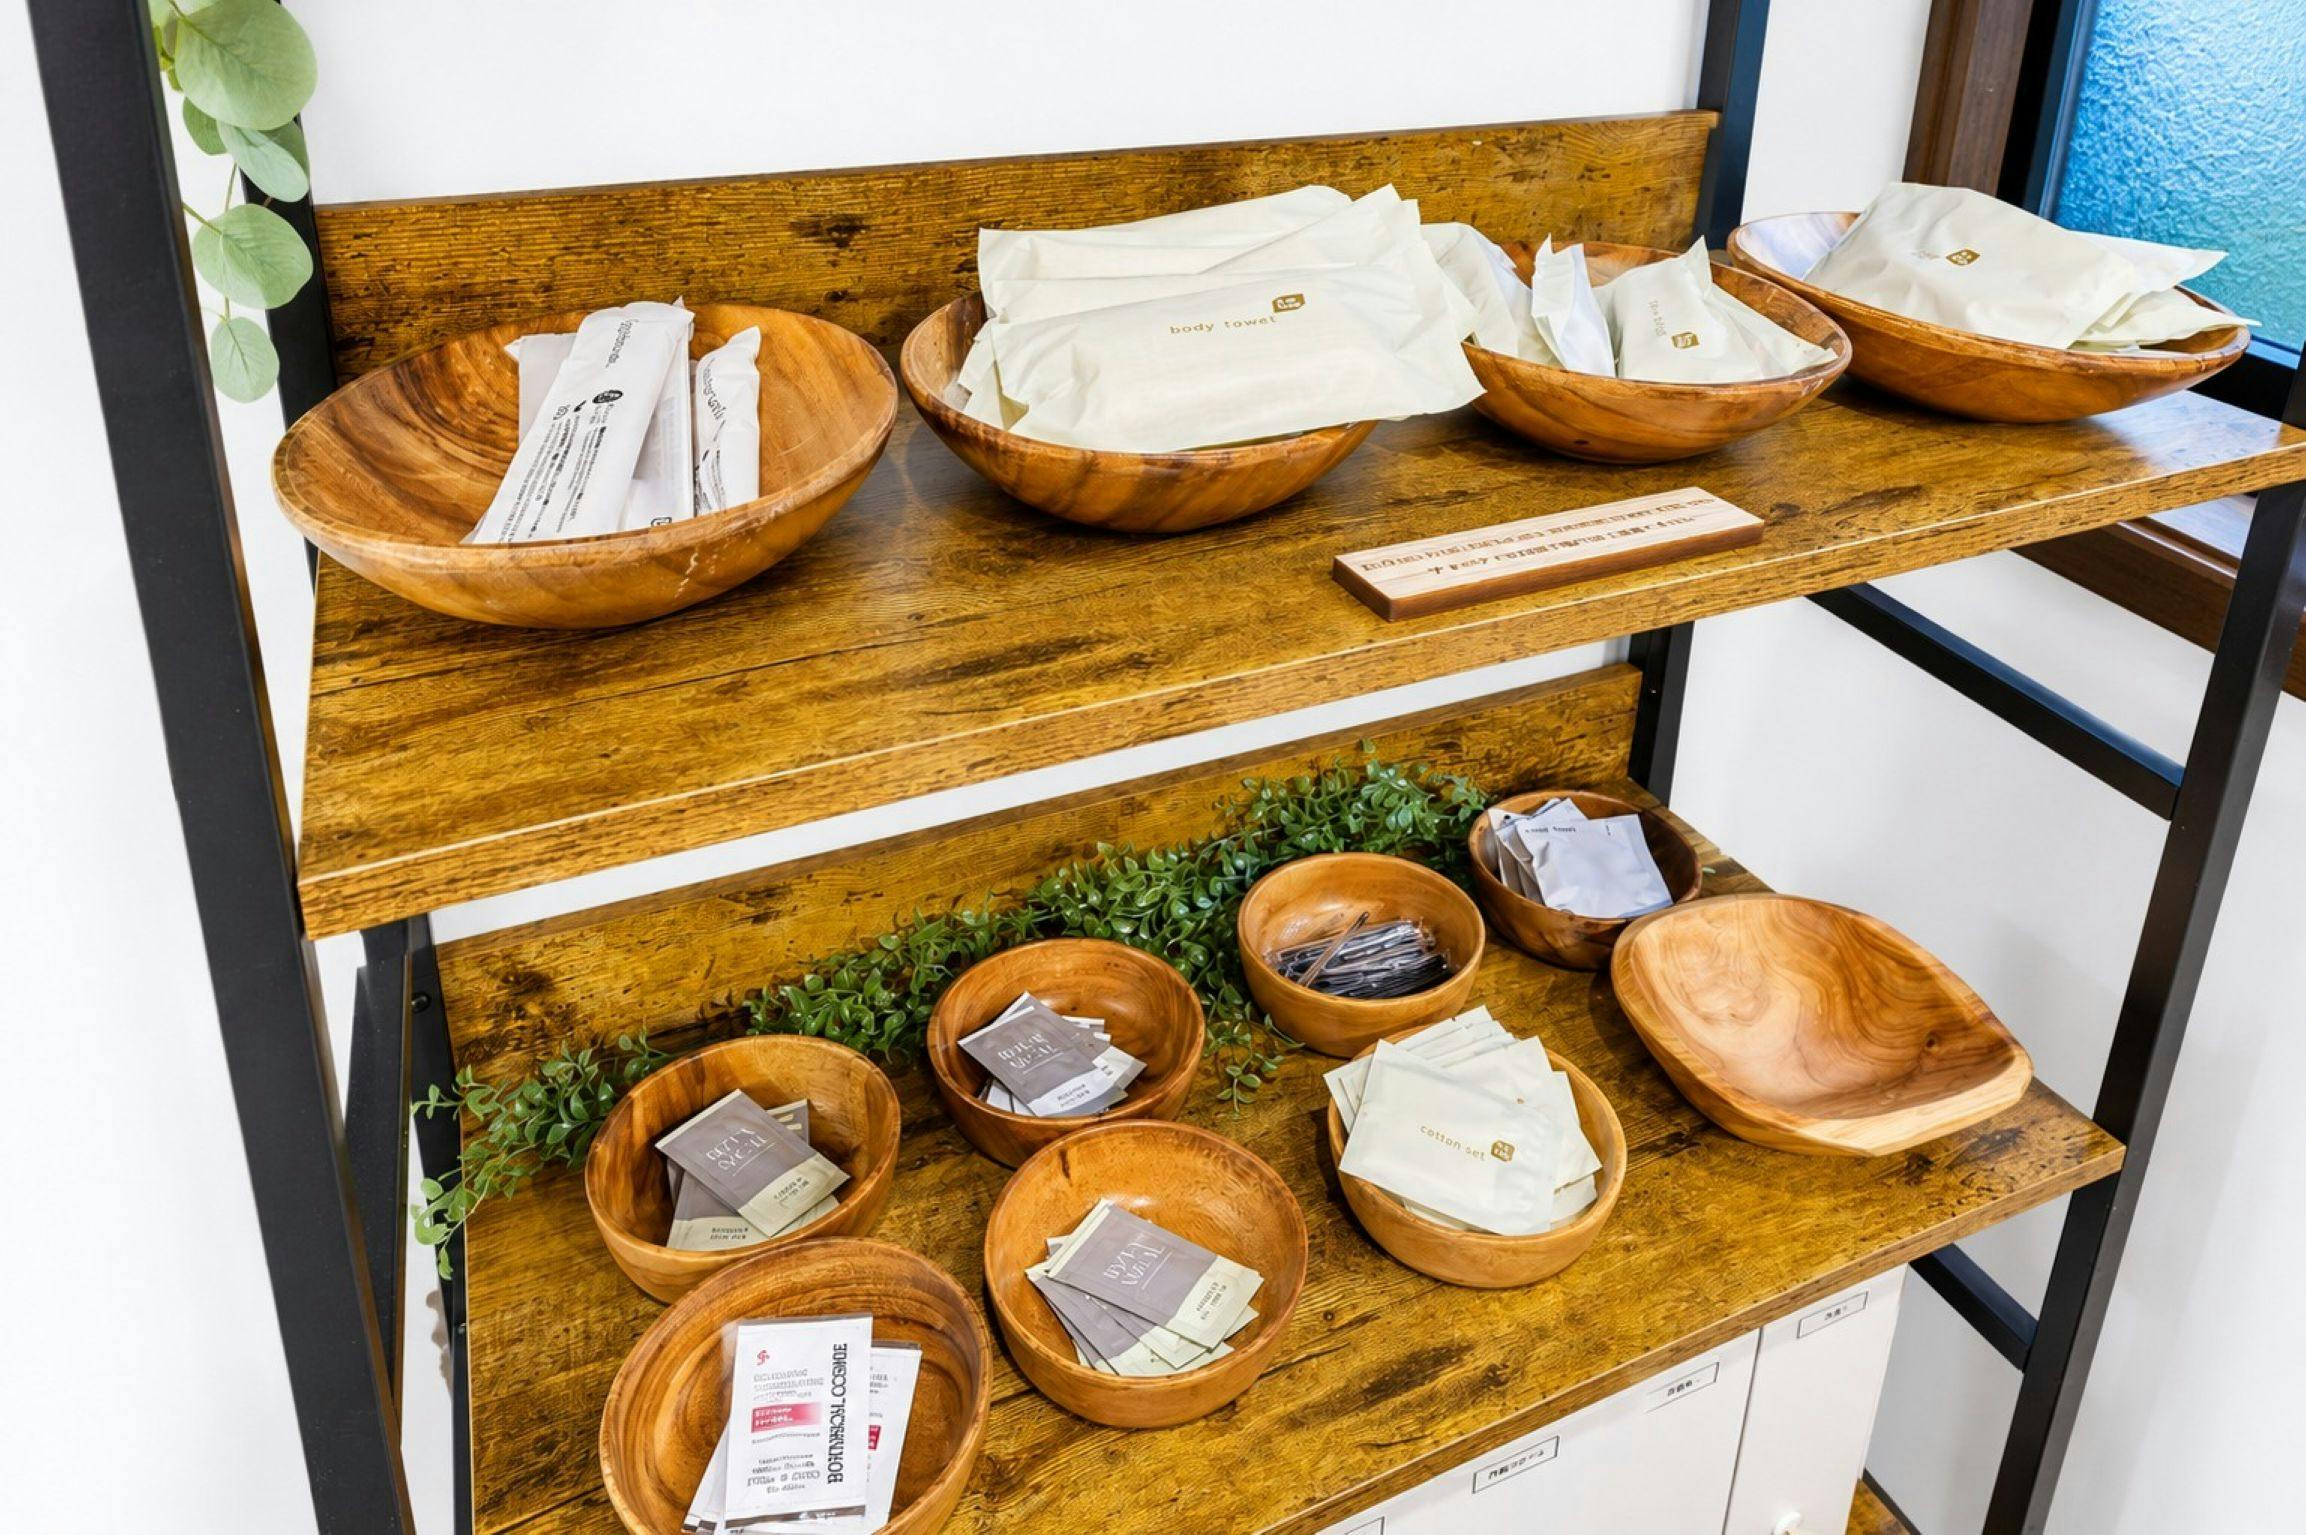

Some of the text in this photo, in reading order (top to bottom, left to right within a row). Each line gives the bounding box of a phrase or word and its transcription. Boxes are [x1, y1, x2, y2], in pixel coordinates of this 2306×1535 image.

[1169, 322, 1214, 334] body
[1420, 1126, 1462, 1150] cotton
[1465, 1146, 1486, 1161] set
